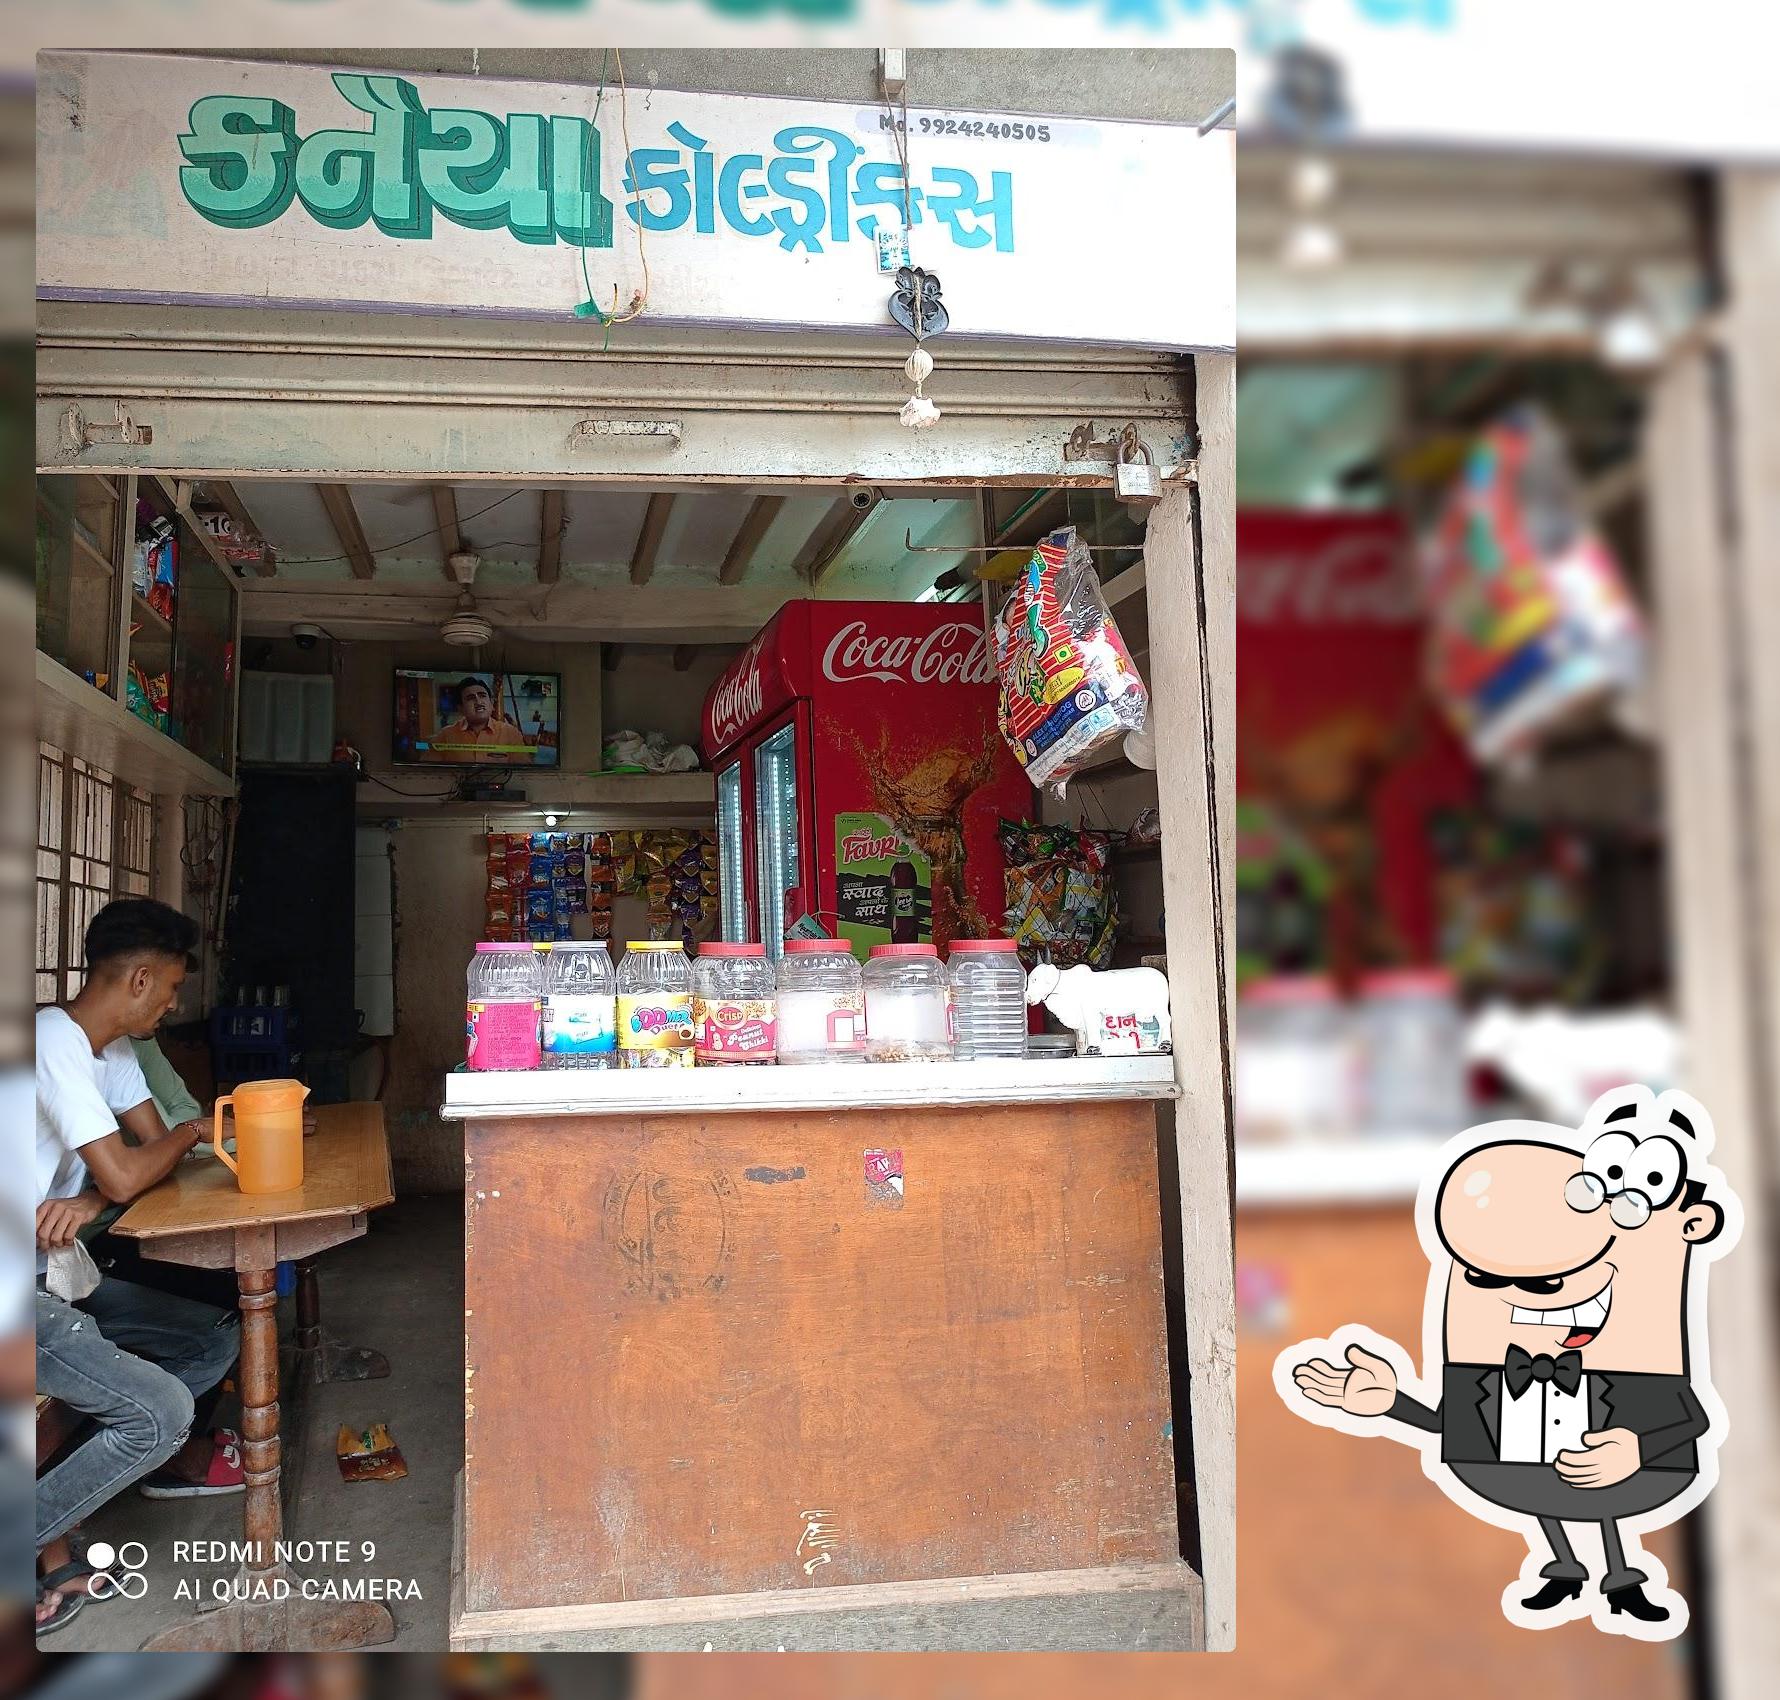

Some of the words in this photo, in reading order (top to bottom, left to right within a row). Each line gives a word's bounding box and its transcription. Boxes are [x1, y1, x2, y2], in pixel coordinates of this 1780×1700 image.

[919, 117, 1051, 142] 9924240505
[177, 73, 613, 248] કનૈયા
[712, 633, 765, 744] Coca-Cola
[843, 886, 886, 900] स्वाद
[855, 904, 888, 917] साथ
[718, 1011, 743, 1022] Crisp
[1105, 1015, 1137, 1029] દાન
[739, 1036, 769, 1051] Chikki
